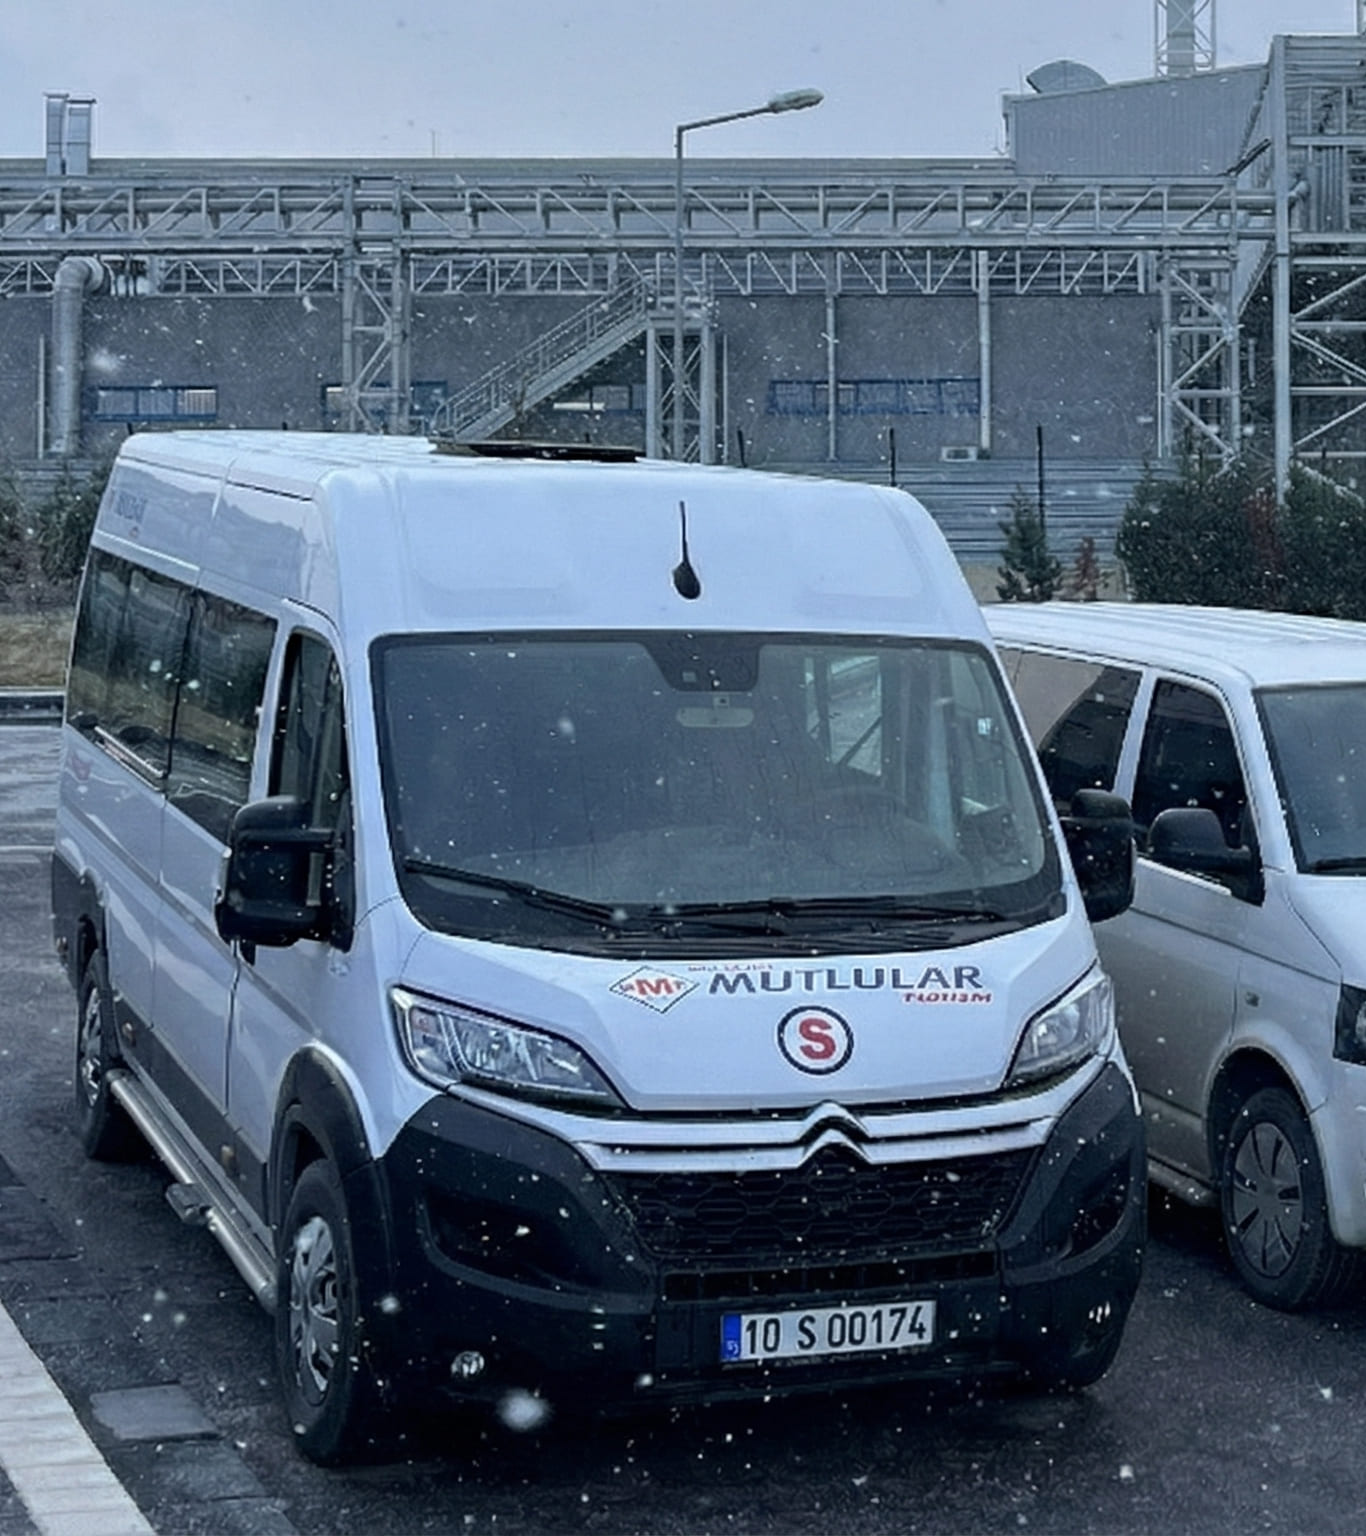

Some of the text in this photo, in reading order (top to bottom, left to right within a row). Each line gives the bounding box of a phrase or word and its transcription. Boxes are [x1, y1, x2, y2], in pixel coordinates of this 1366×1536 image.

[708, 965, 983, 996] MUTLULAR
[799, 1018, 836, 1060] S
[746, 1305, 926, 1354] 10 S 00174
